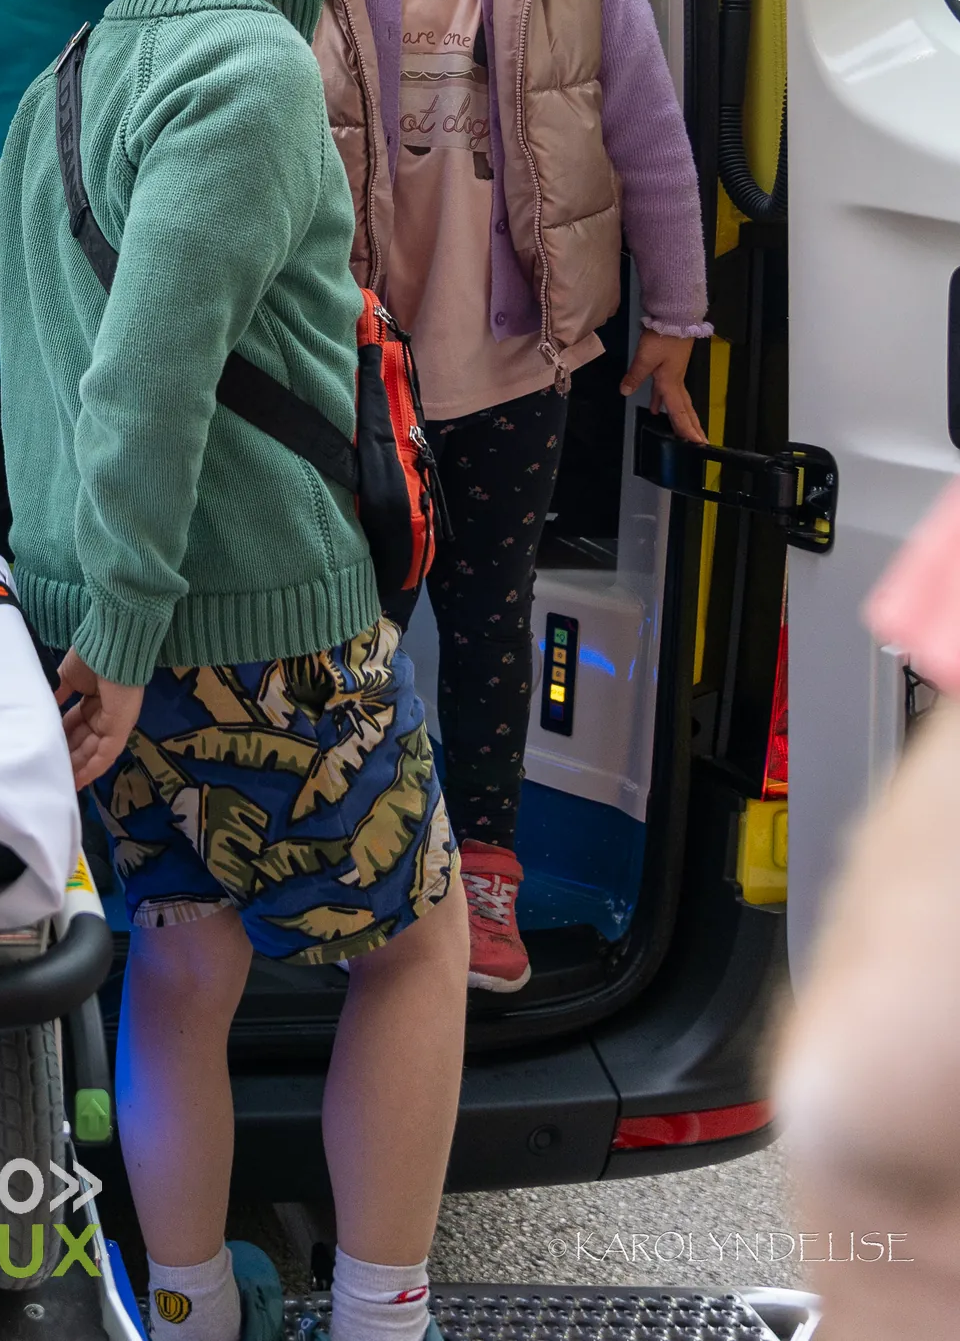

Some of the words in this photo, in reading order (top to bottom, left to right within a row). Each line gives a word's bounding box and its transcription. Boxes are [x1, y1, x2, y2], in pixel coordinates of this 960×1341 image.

[402, 31, 435, 45] are
[443, 32, 471, 48] one
[400, 94, 439, 134] ot
[442, 93, 491, 149] dog
